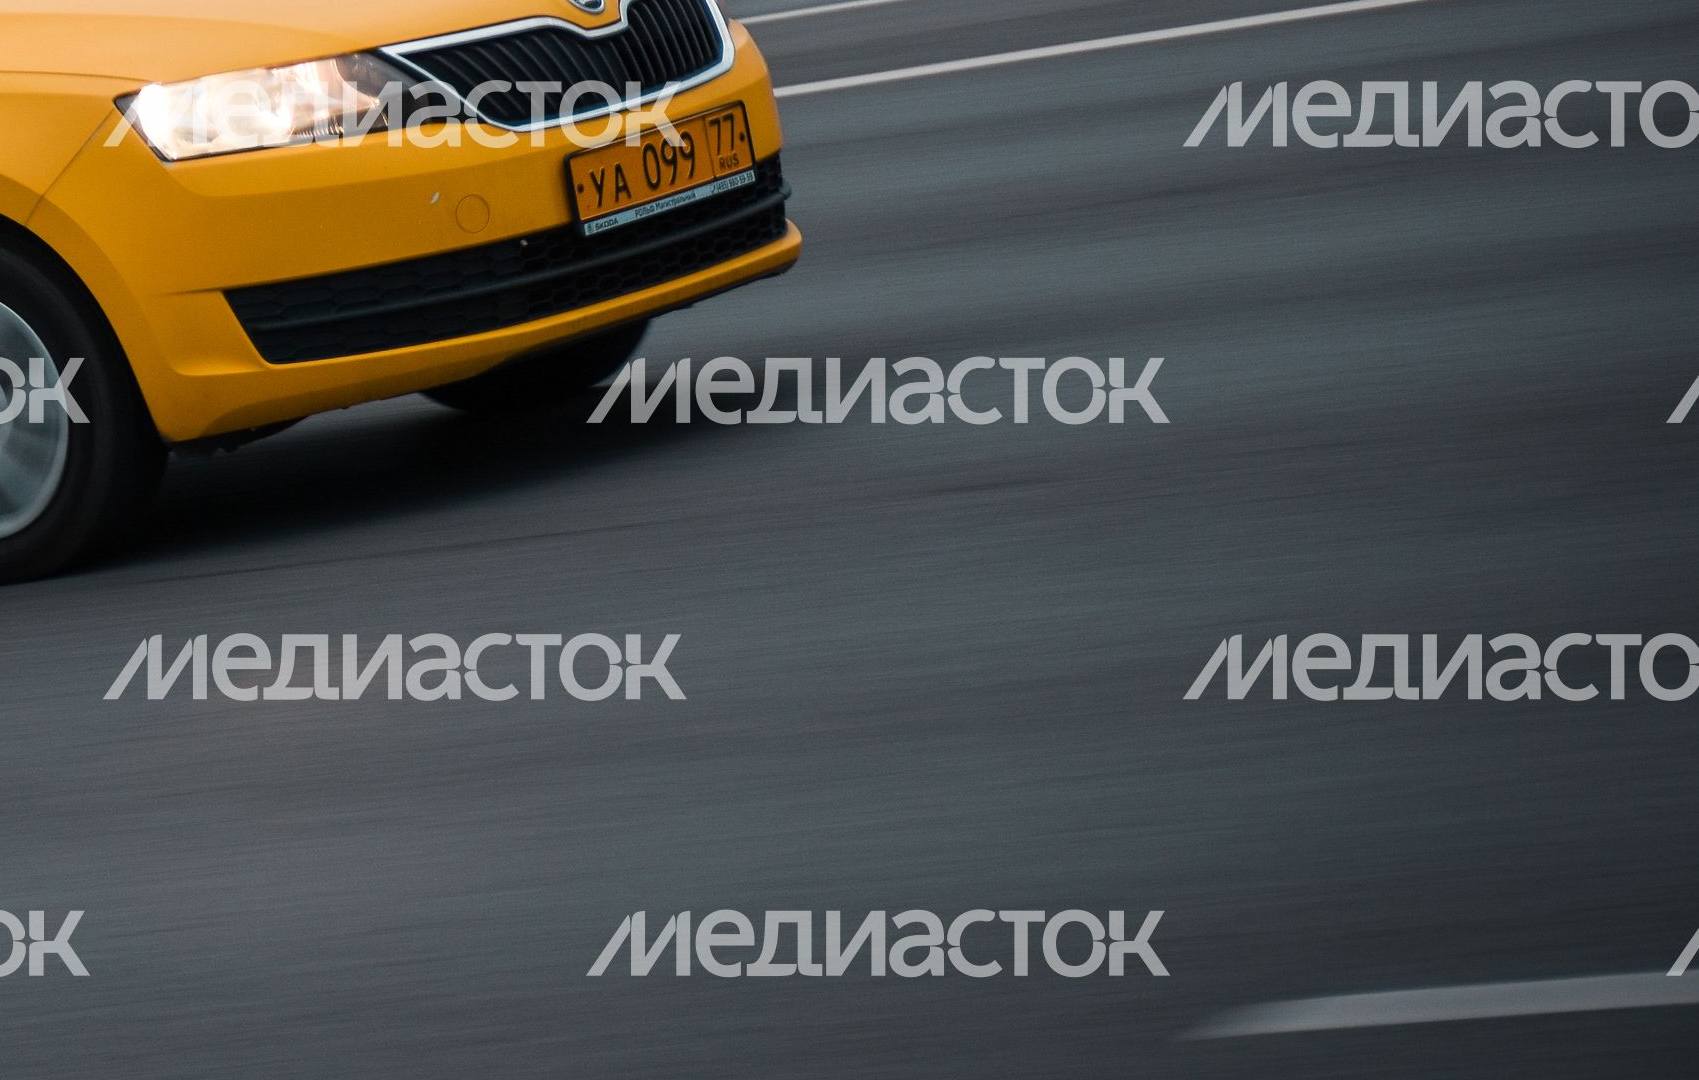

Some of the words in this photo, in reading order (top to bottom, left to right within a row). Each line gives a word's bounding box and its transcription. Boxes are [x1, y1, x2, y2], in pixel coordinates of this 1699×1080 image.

[642, 132, 696, 190] 099
[709, 114, 735, 155] 77
[719, 153, 740, 171] RUS
